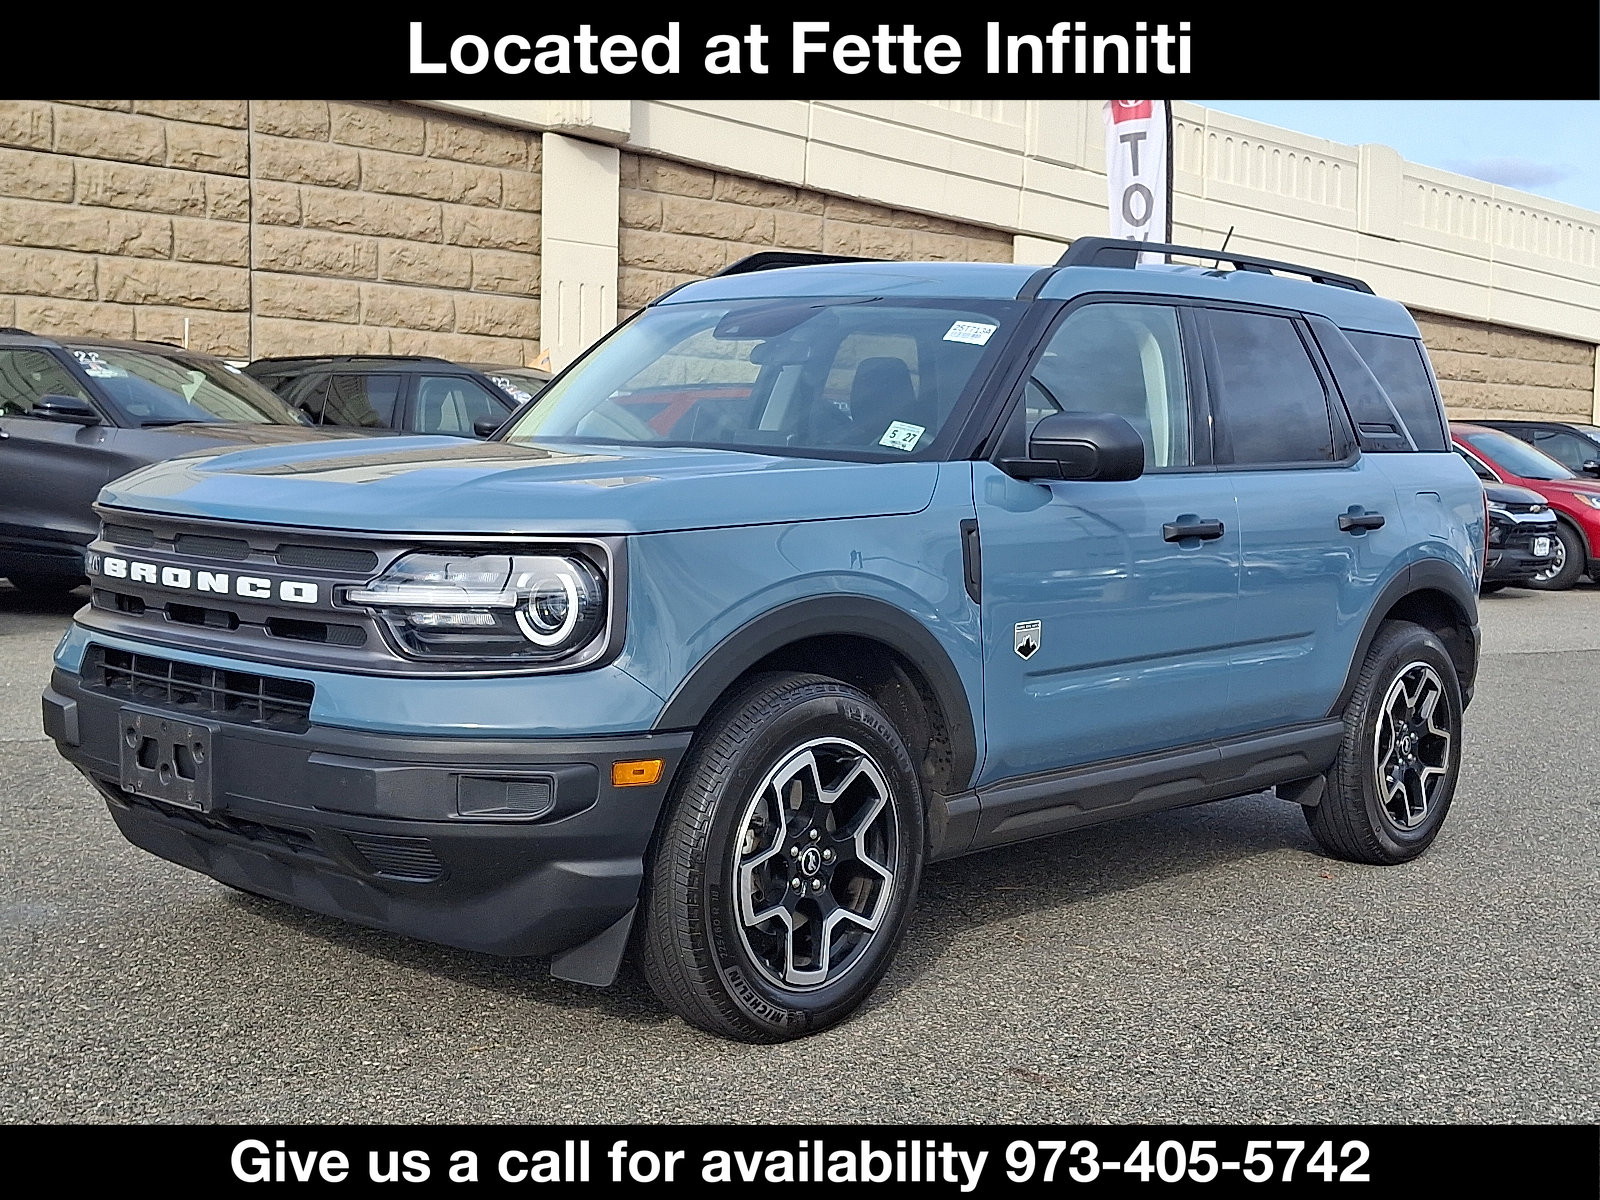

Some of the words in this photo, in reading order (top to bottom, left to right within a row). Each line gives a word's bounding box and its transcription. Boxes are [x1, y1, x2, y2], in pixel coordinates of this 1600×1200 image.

[889, 429, 899, 438] 5
[902, 432, 917, 443] 27
[104, 556, 318, 604] BRONCO
[728, 970, 784, 1023] MICHELIN
